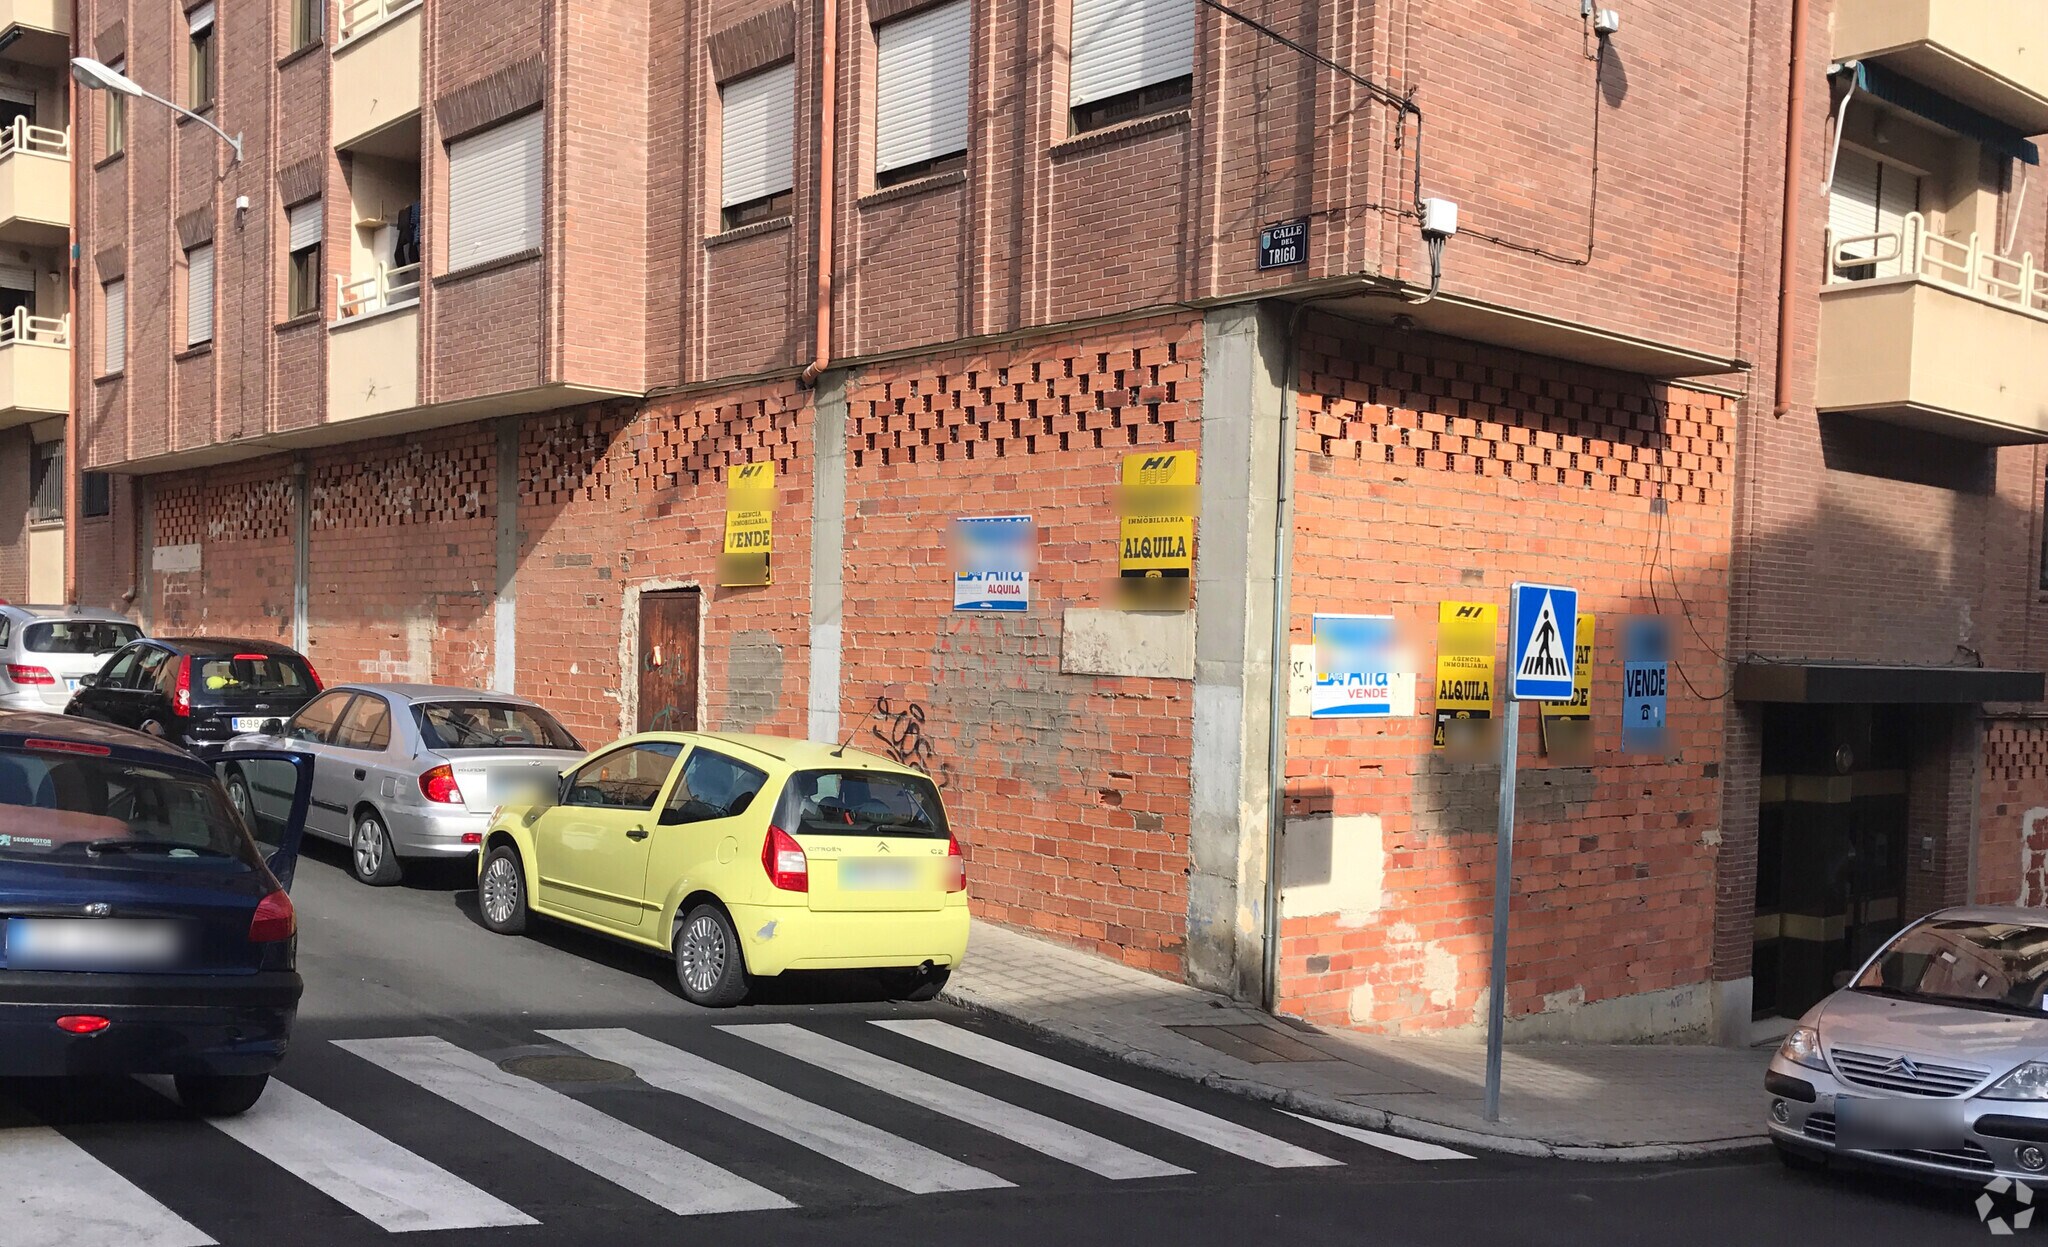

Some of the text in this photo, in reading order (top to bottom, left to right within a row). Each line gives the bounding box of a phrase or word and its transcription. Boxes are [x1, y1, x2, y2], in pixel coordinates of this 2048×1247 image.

[1273, 226, 1302, 239] CALLE
[1269, 246, 1296, 264] TRIGO
[731, 518, 768, 527] INMOBILIARIA
[1128, 517, 1184, 525] INMOBILIARIA
[728, 530, 770, 548] VENDE
[1123, 536, 1186, 559] ALQUILA
[988, 585, 1021, 594] ALQUILA
[1443, 661, 1488, 669] INMOBILIARIA
[1626, 669, 1665, 697] VENDE
[1348, 688, 1388, 698] VENDE
[1439, 680, 1490, 701] ALQUILA
